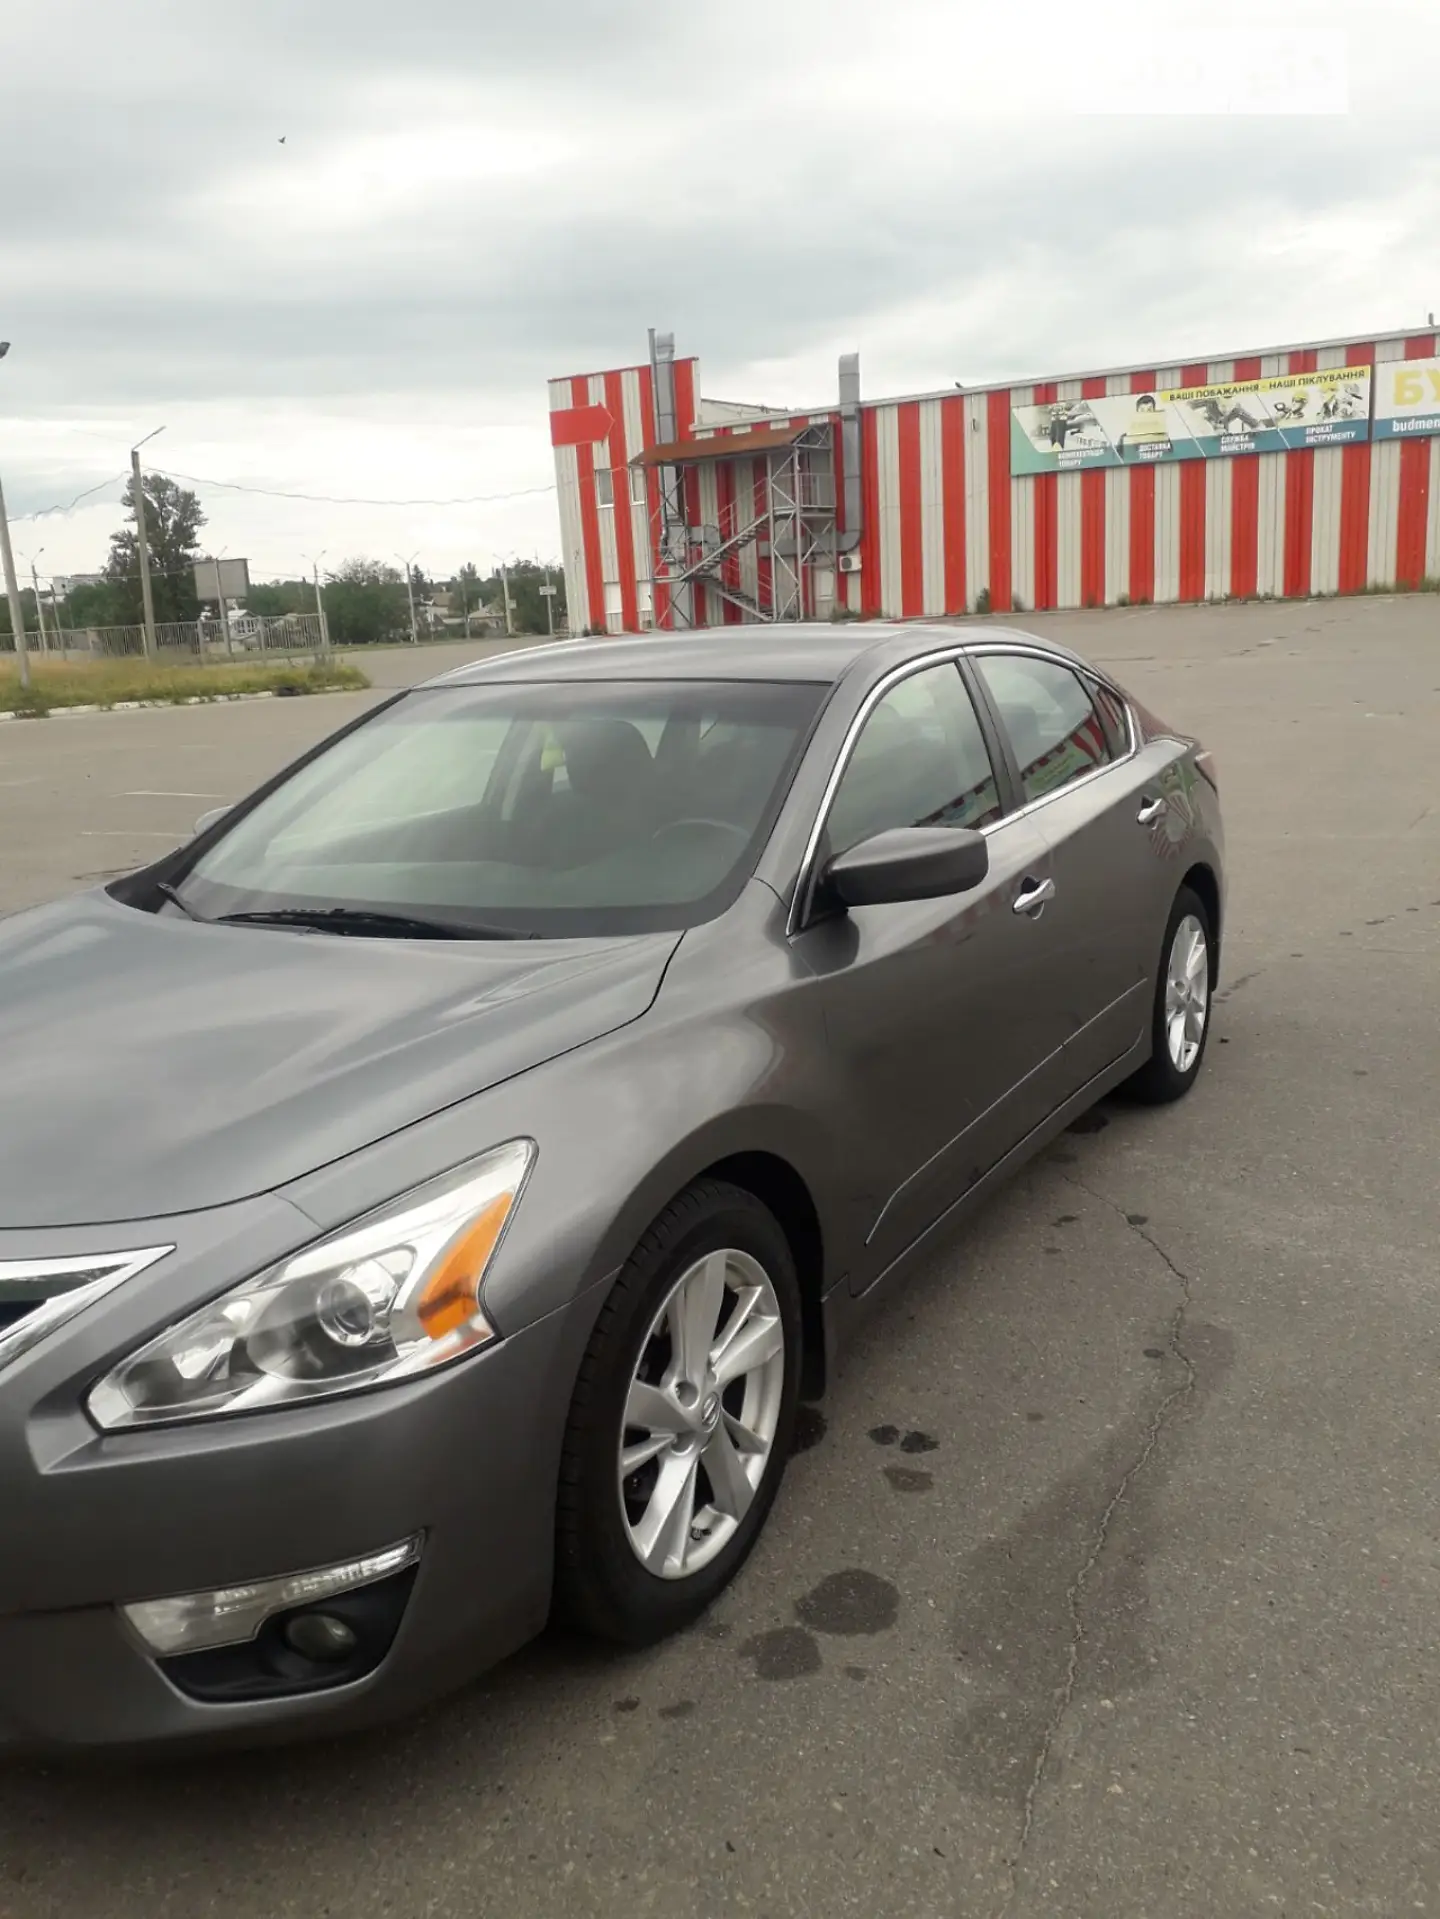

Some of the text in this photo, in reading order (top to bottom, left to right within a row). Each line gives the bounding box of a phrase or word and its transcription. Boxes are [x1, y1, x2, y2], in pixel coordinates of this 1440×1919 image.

[1169, 391, 1194, 401] ВАШІ
[1195, 384, 1259, 398] ПОБАЖАННЯ
[1269, 377, 1295, 389] НАШІ
[1298, 370, 1364, 386] ПІКЛУВАННЯ
